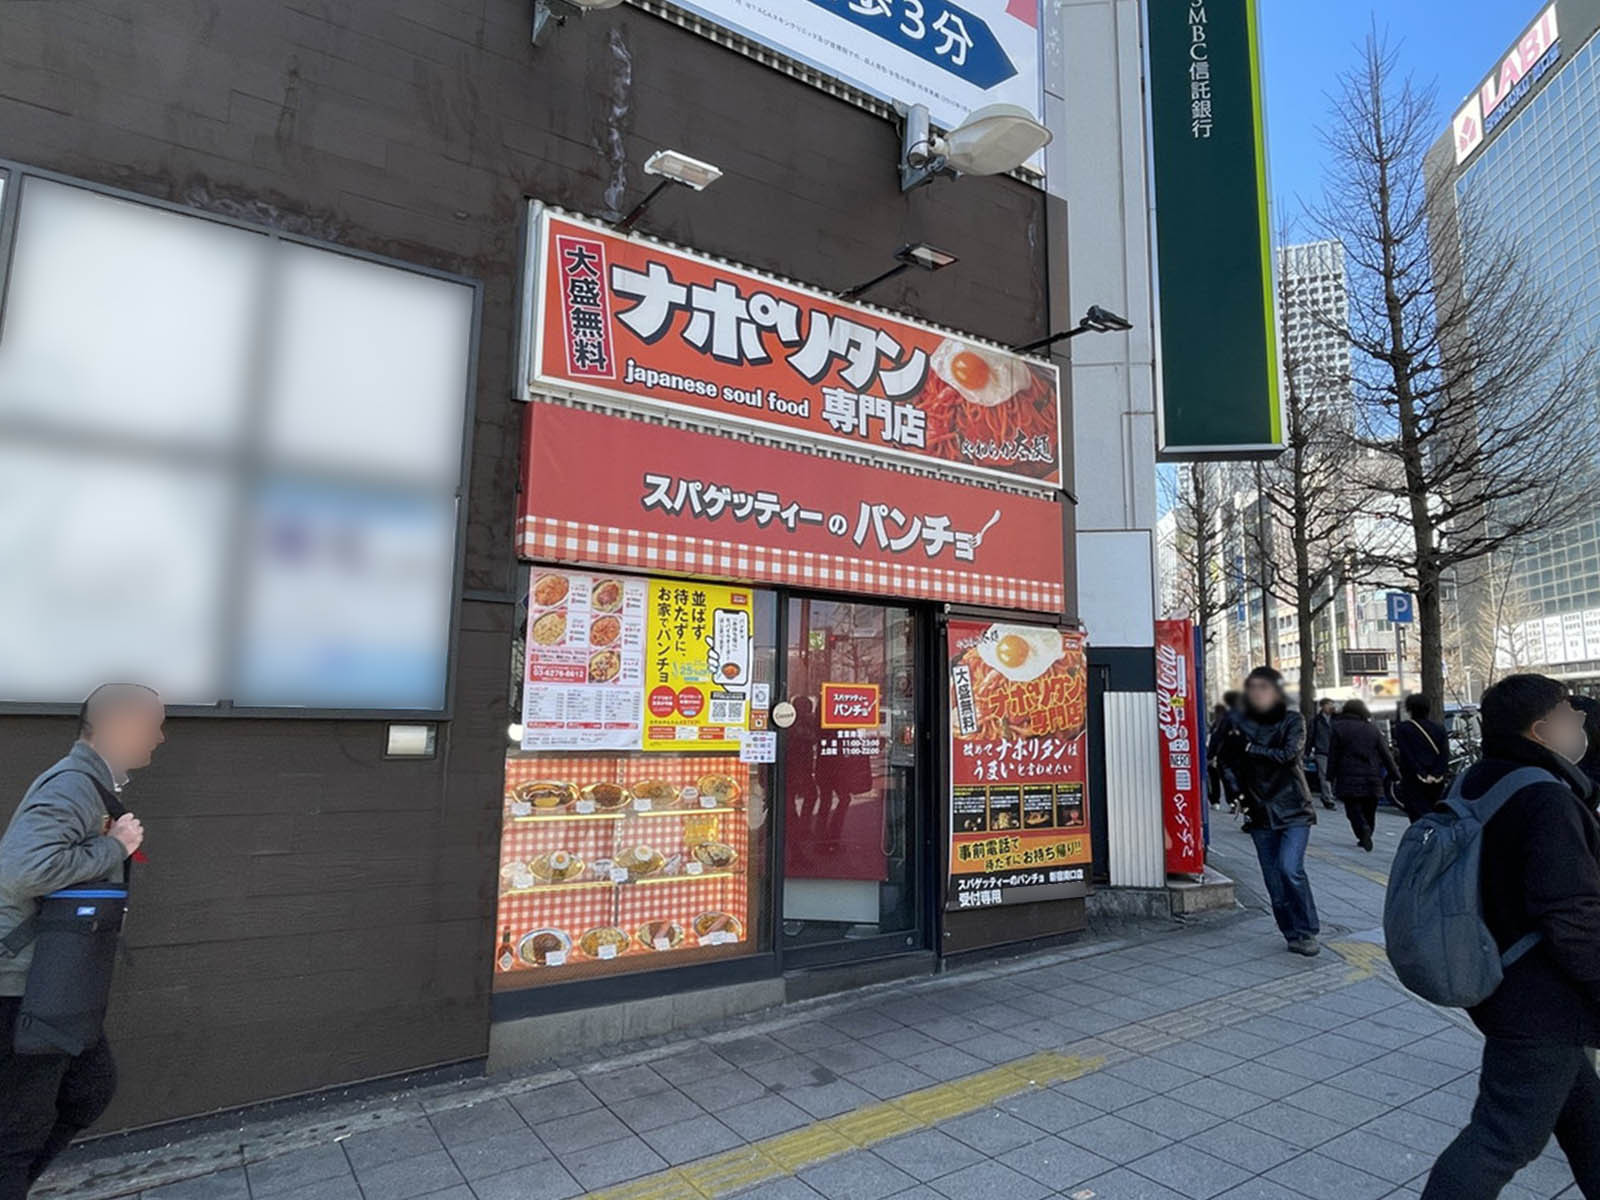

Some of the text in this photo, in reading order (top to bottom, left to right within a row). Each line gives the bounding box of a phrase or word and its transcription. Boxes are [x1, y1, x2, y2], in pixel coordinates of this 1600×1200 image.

[1481, 13, 1553, 118] LABI
[565, 246, 606, 371] 大盛無料
[611, 261, 929, 399] ナポリタン
[625, 358, 809, 418] japanese soul food
[821, 386, 926, 448] 専門店
[656, 587, 672, 683] お家でパンチョ
[691, 590, 706, 641] 並ばず
[1393, 595, 1408, 620] P
[989, 675, 1082, 718] ナポリタン
[1031, 702, 1083, 734] 専門店
[959, 836, 1019, 861] 事前電話で
